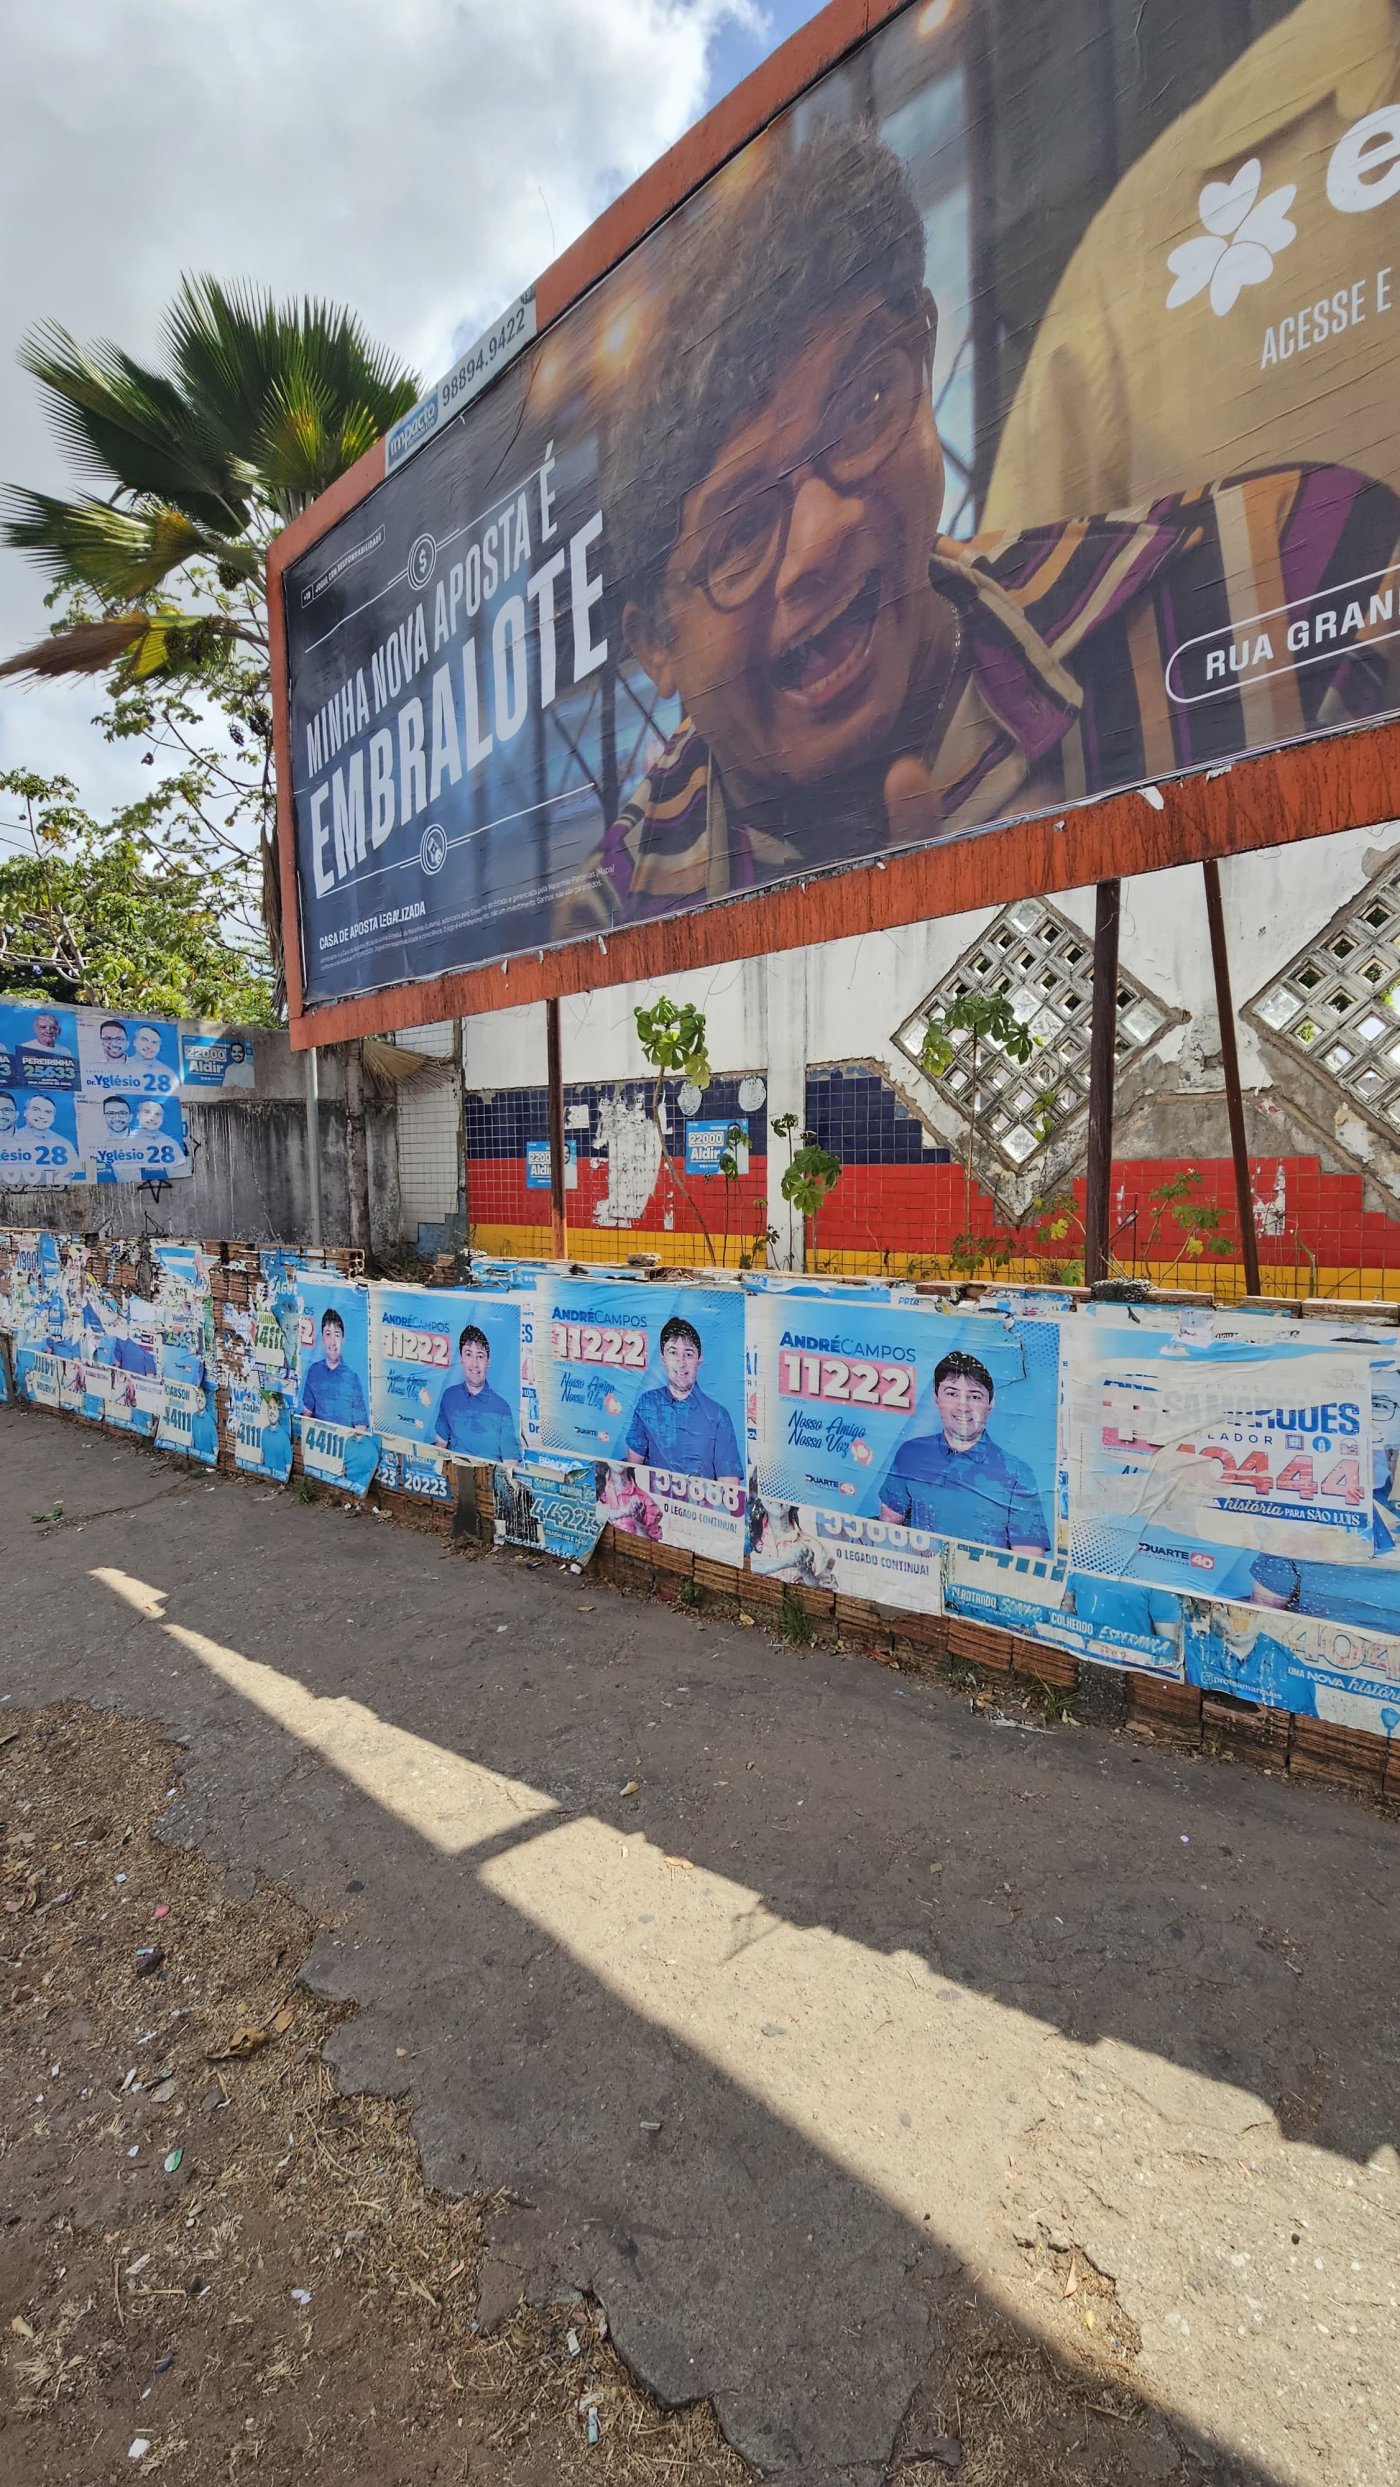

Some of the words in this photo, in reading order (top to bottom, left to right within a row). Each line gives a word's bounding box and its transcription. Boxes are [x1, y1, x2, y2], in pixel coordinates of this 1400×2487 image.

[1261, 280, 1366, 370] ACESSE
[1377, 267, 1391, 315] E
[442, 307, 526, 407] 98894.9422
[306, 666, 370, 778] MINHA
[372, 603, 429, 713] NOVA
[433, 491, 532, 652] APOSTA
[539, 439, 558, 543] É
[1206, 633, 1274, 681] RUA
[1287, 587, 1400, 651] GRAN
[310, 509, 608, 899] EMBRALOTE
[320, 932, 339, 950] CASA
[339, 928, 349, 943] DE
[350, 917, 378, 941] APOSTA
[379, 901, 426, 928] LEGALIZADA
[186, 1047, 226, 1060] 22000
[23, 1065, 76, 1079] 25633
[189, 1060, 224, 1074] Aldir
[94, 1074, 141, 1089] Yglésio
[143, 1073, 171, 1092] 28
[688, 1132, 724, 1146] 22000
[0, 1148, 32, 1162] ésio
[35, 1145, 68, 1166] 28
[98, 1148, 144, 1164] Yglésio
[147, 1145, 175, 1164] 28
[530, 1153, 551, 1163] 2200
[691, 1146, 721, 1160] Aldir
[531, 1164, 552, 1175] Aldi
[383, 1329, 450, 1368] 11222
[553, 1323, 646, 1368] 11222
[784, 1354, 911, 1409] 11222
[236, 1423, 261, 1449] 4111
[574, 1426, 598, 1437] DUARTE
[788, 1410, 823, 1431] Nosso
[825, 1416, 867, 1442] Amigo
[1208, 1432, 1273, 1445] ADOR
[305, 1427, 345, 1459] 44111
[788, 1428, 822, 1449] Nossa
[825, 1434, 850, 1459] Voz
[374, 1466, 397, 1487] 223
[404, 1473, 447, 1497] 20223
[805, 1474, 839, 1489] DUARTE
[664, 1503, 669, 1512] O
[671, 1504, 697, 1521] LEGADO
[699, 1513, 737, 1533] CONTINUA!
[1223, 1497, 1283, 1516] história
[1284, 1507, 1306, 1520] PARA
[1307, 1506, 1331, 1524] SÃO
[836, 1548, 842, 1558] O
[845, 1549, 878, 1566] LEGADO
[881, 1556, 929, 1576] CONTINUA!
[1139, 1542, 1190, 1561] DUARTE
[1191, 1554, 1215, 1569] 40
[1051, 1612, 1094, 1636] COLHENDO
[1099, 1625, 1171, 1655] ESPERANÇA
[1288, 1667, 1304, 1679] UMA
[1307, 1671, 1345, 1688] NOVA
